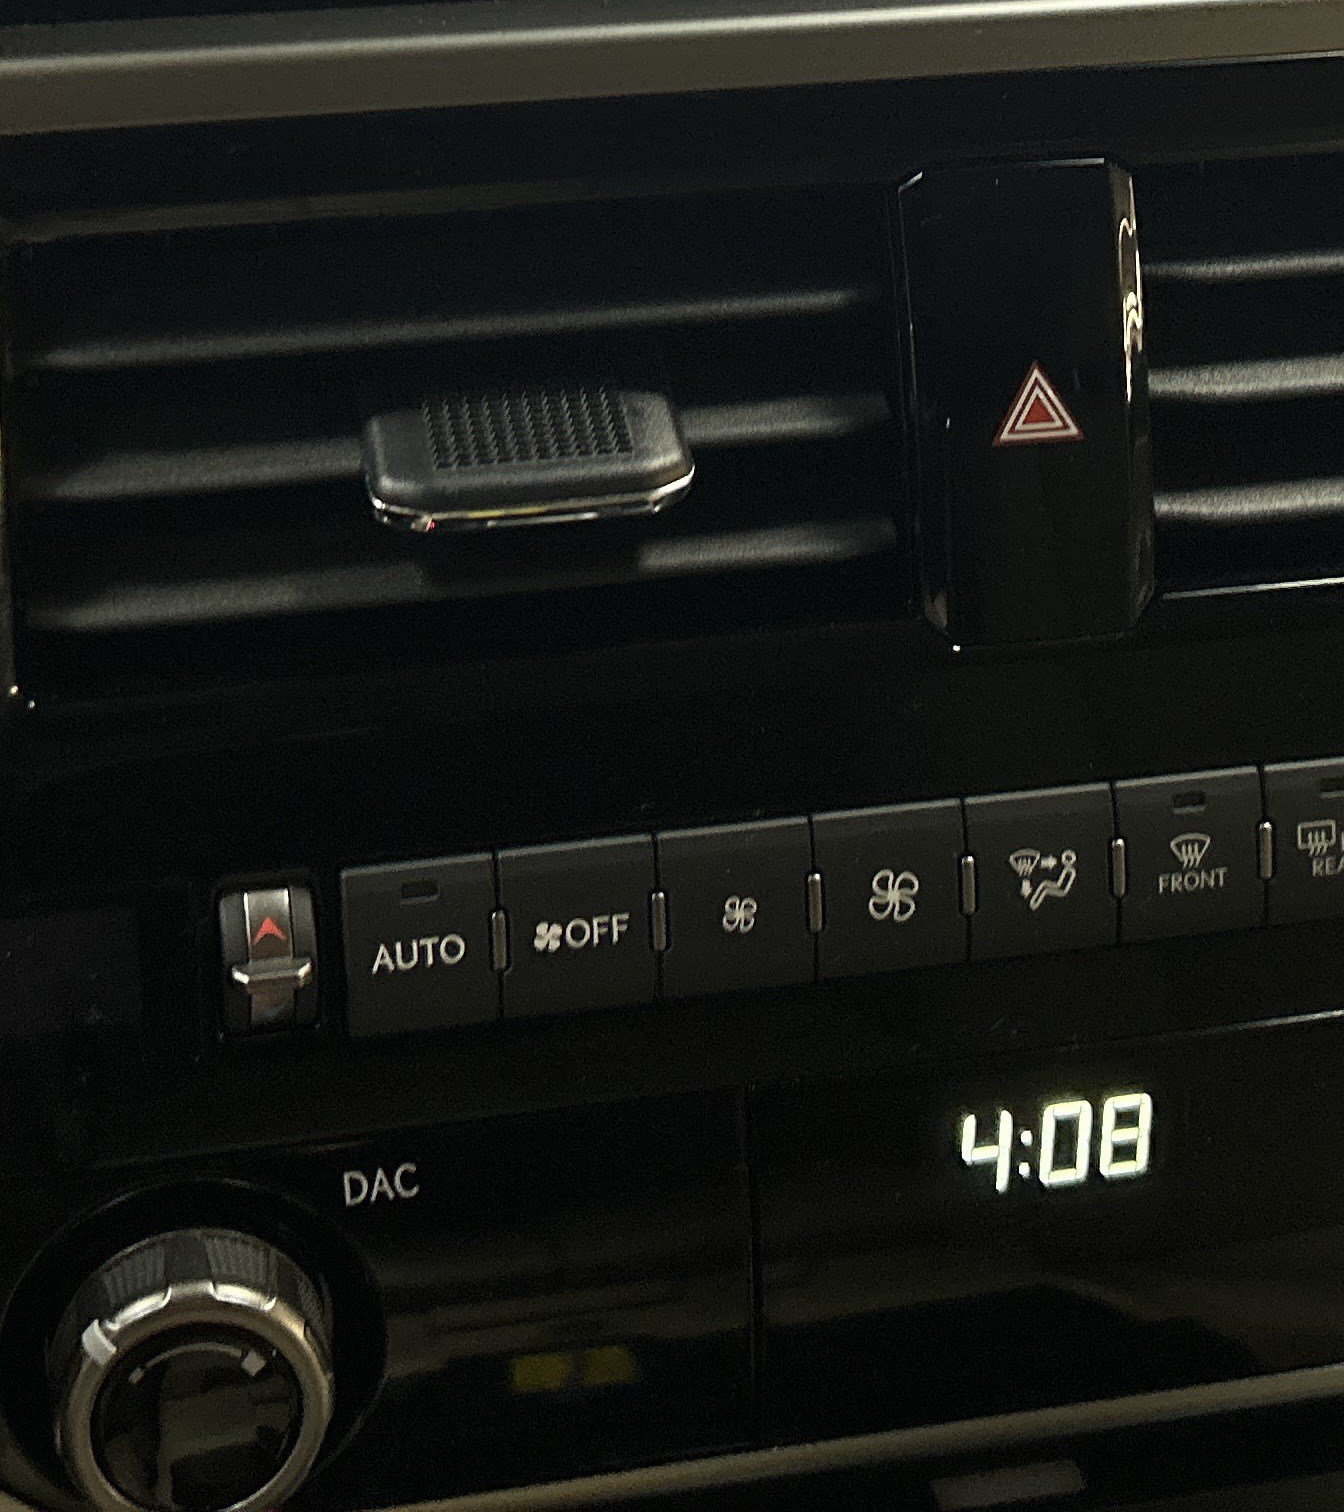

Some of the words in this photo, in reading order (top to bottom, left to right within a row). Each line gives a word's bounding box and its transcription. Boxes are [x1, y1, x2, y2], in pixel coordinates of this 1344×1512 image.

[1158, 867, 1227, 893] FRONT
[565, 913, 631, 947] OFF
[371, 933, 466, 973] AUTO
[960, 1092, 1154, 1192] 4:08
[342, 1162, 420, 1208] DAC
